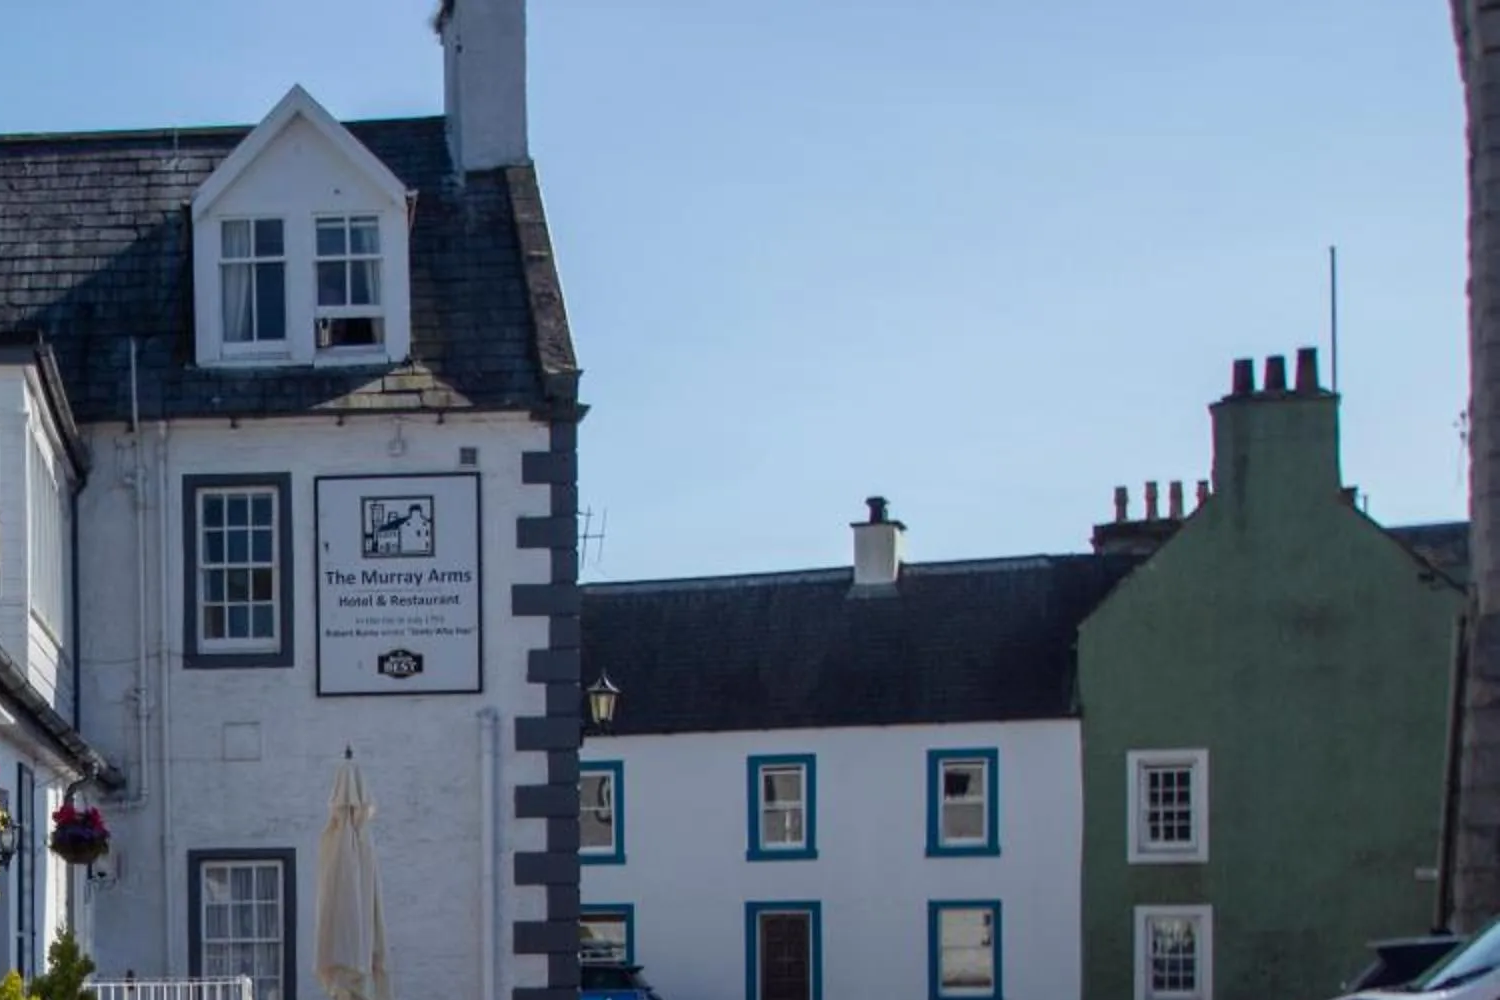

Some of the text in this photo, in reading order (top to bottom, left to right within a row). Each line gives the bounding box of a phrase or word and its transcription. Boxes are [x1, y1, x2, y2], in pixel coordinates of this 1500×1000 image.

[325, 568, 472, 586] The Murray Arms
[339, 594, 460, 607] Hotel & Restaurant
